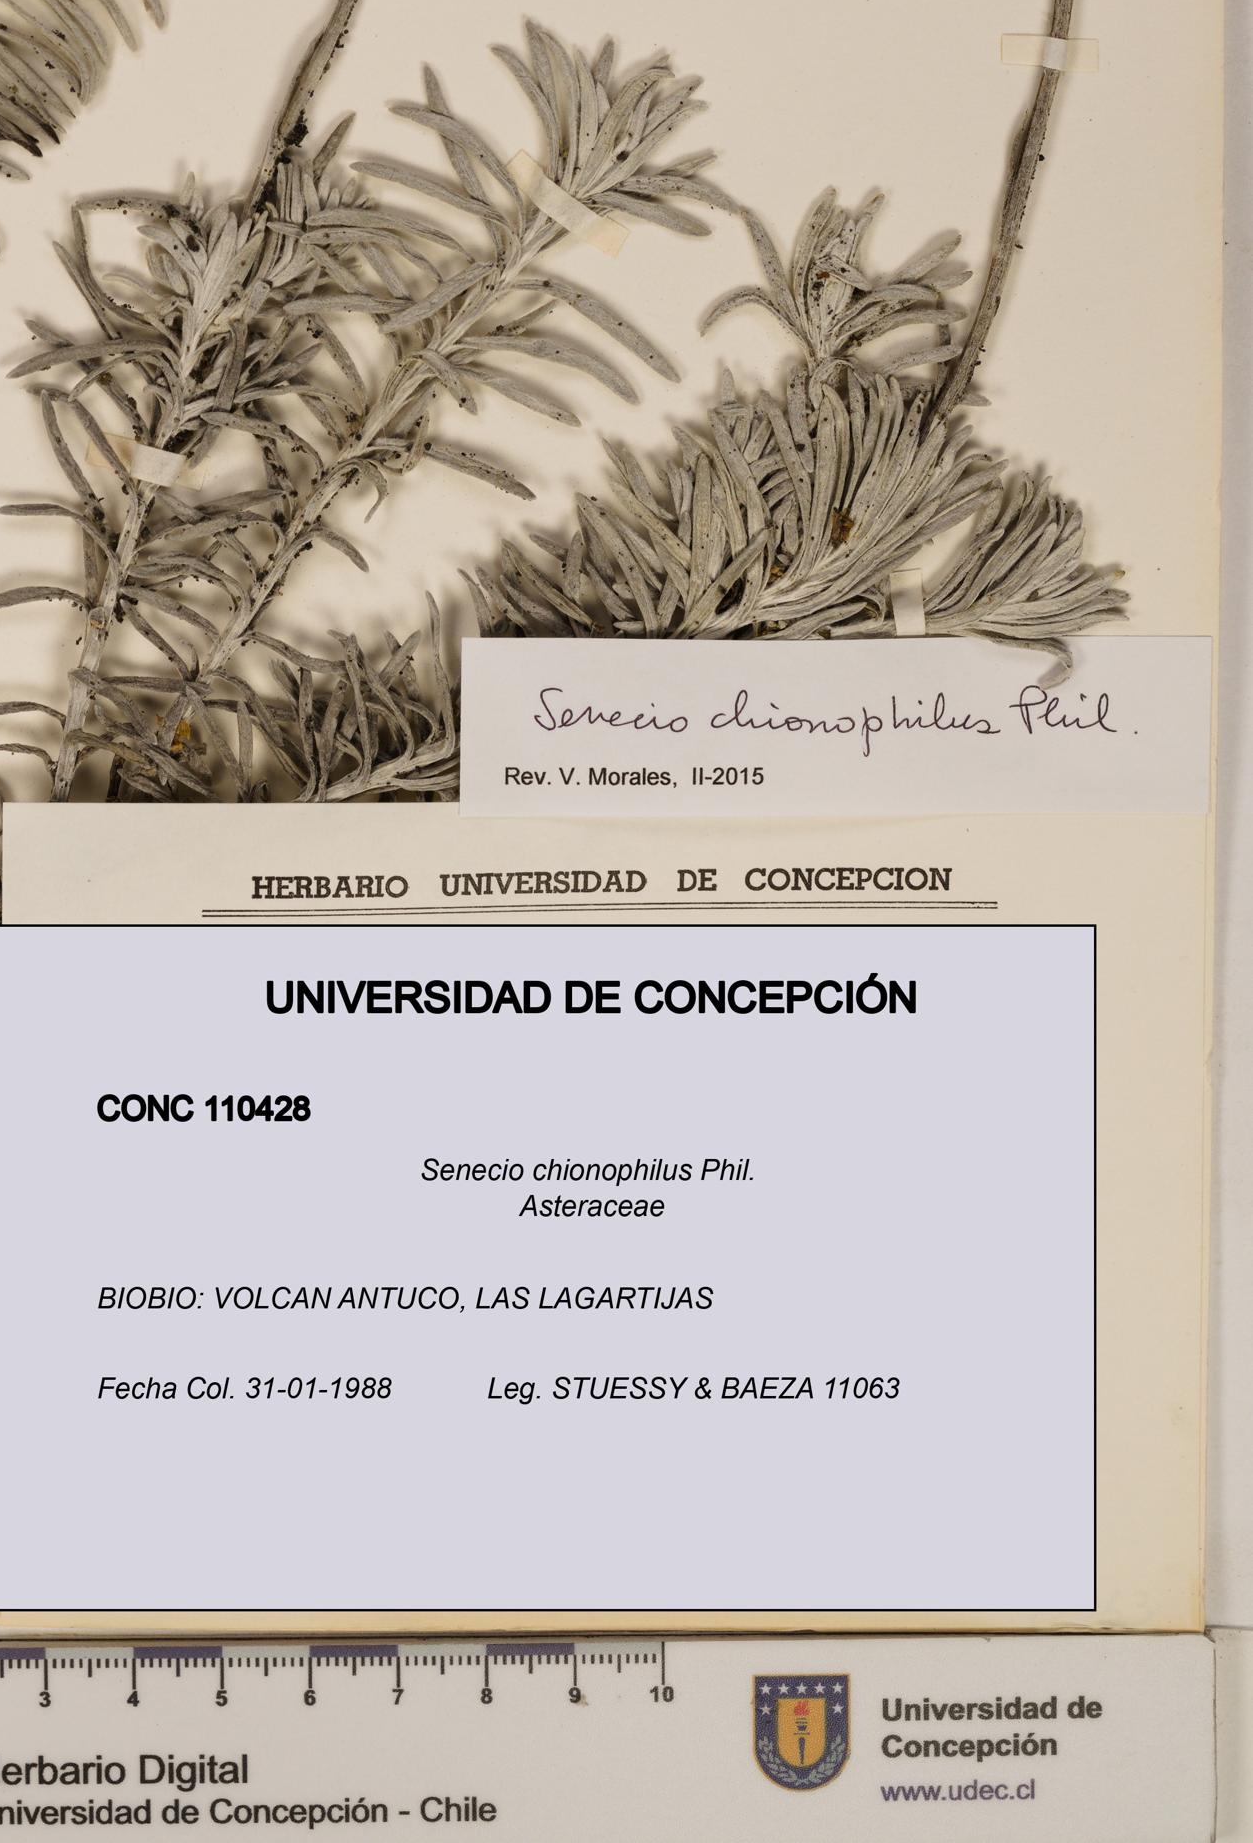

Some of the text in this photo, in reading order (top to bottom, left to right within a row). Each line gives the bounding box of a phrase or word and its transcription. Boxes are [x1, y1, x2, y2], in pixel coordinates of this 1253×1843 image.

[533, 687, 689, 734] Senecio
[710, 688, 1002, 758] chionophilus
[503, 766, 766, 790] Rev. V. Morales, II-2015
[251, 866, 953, 901] HERBARIO UNIVERSIDAD DE CONCEPCION
[38, 1690, 52, 1709] 3
[126, 1690, 141, 1708] 4
[214, 1689, 229, 1708] 5
[302, 1689, 317, 1707] 6
[391, 1688, 405, 1706] 7
[479, 1687, 494, 1705] 8
[567, 1686, 582, 1705] 9
[648, 1685, 675, 1704] 10
[881, 1694, 1104, 1723] Universidad de
[880, 1732, 1059, 1763] Concepción
[139, 1753, 248, 1789] Digital
[880, 1778, 1037, 1802] www.udec.cl
[161, 1798, 200, 1825] de
[209, 1796, 389, 1830] Concepción
[419, 1796, 498, 1823] Chile
